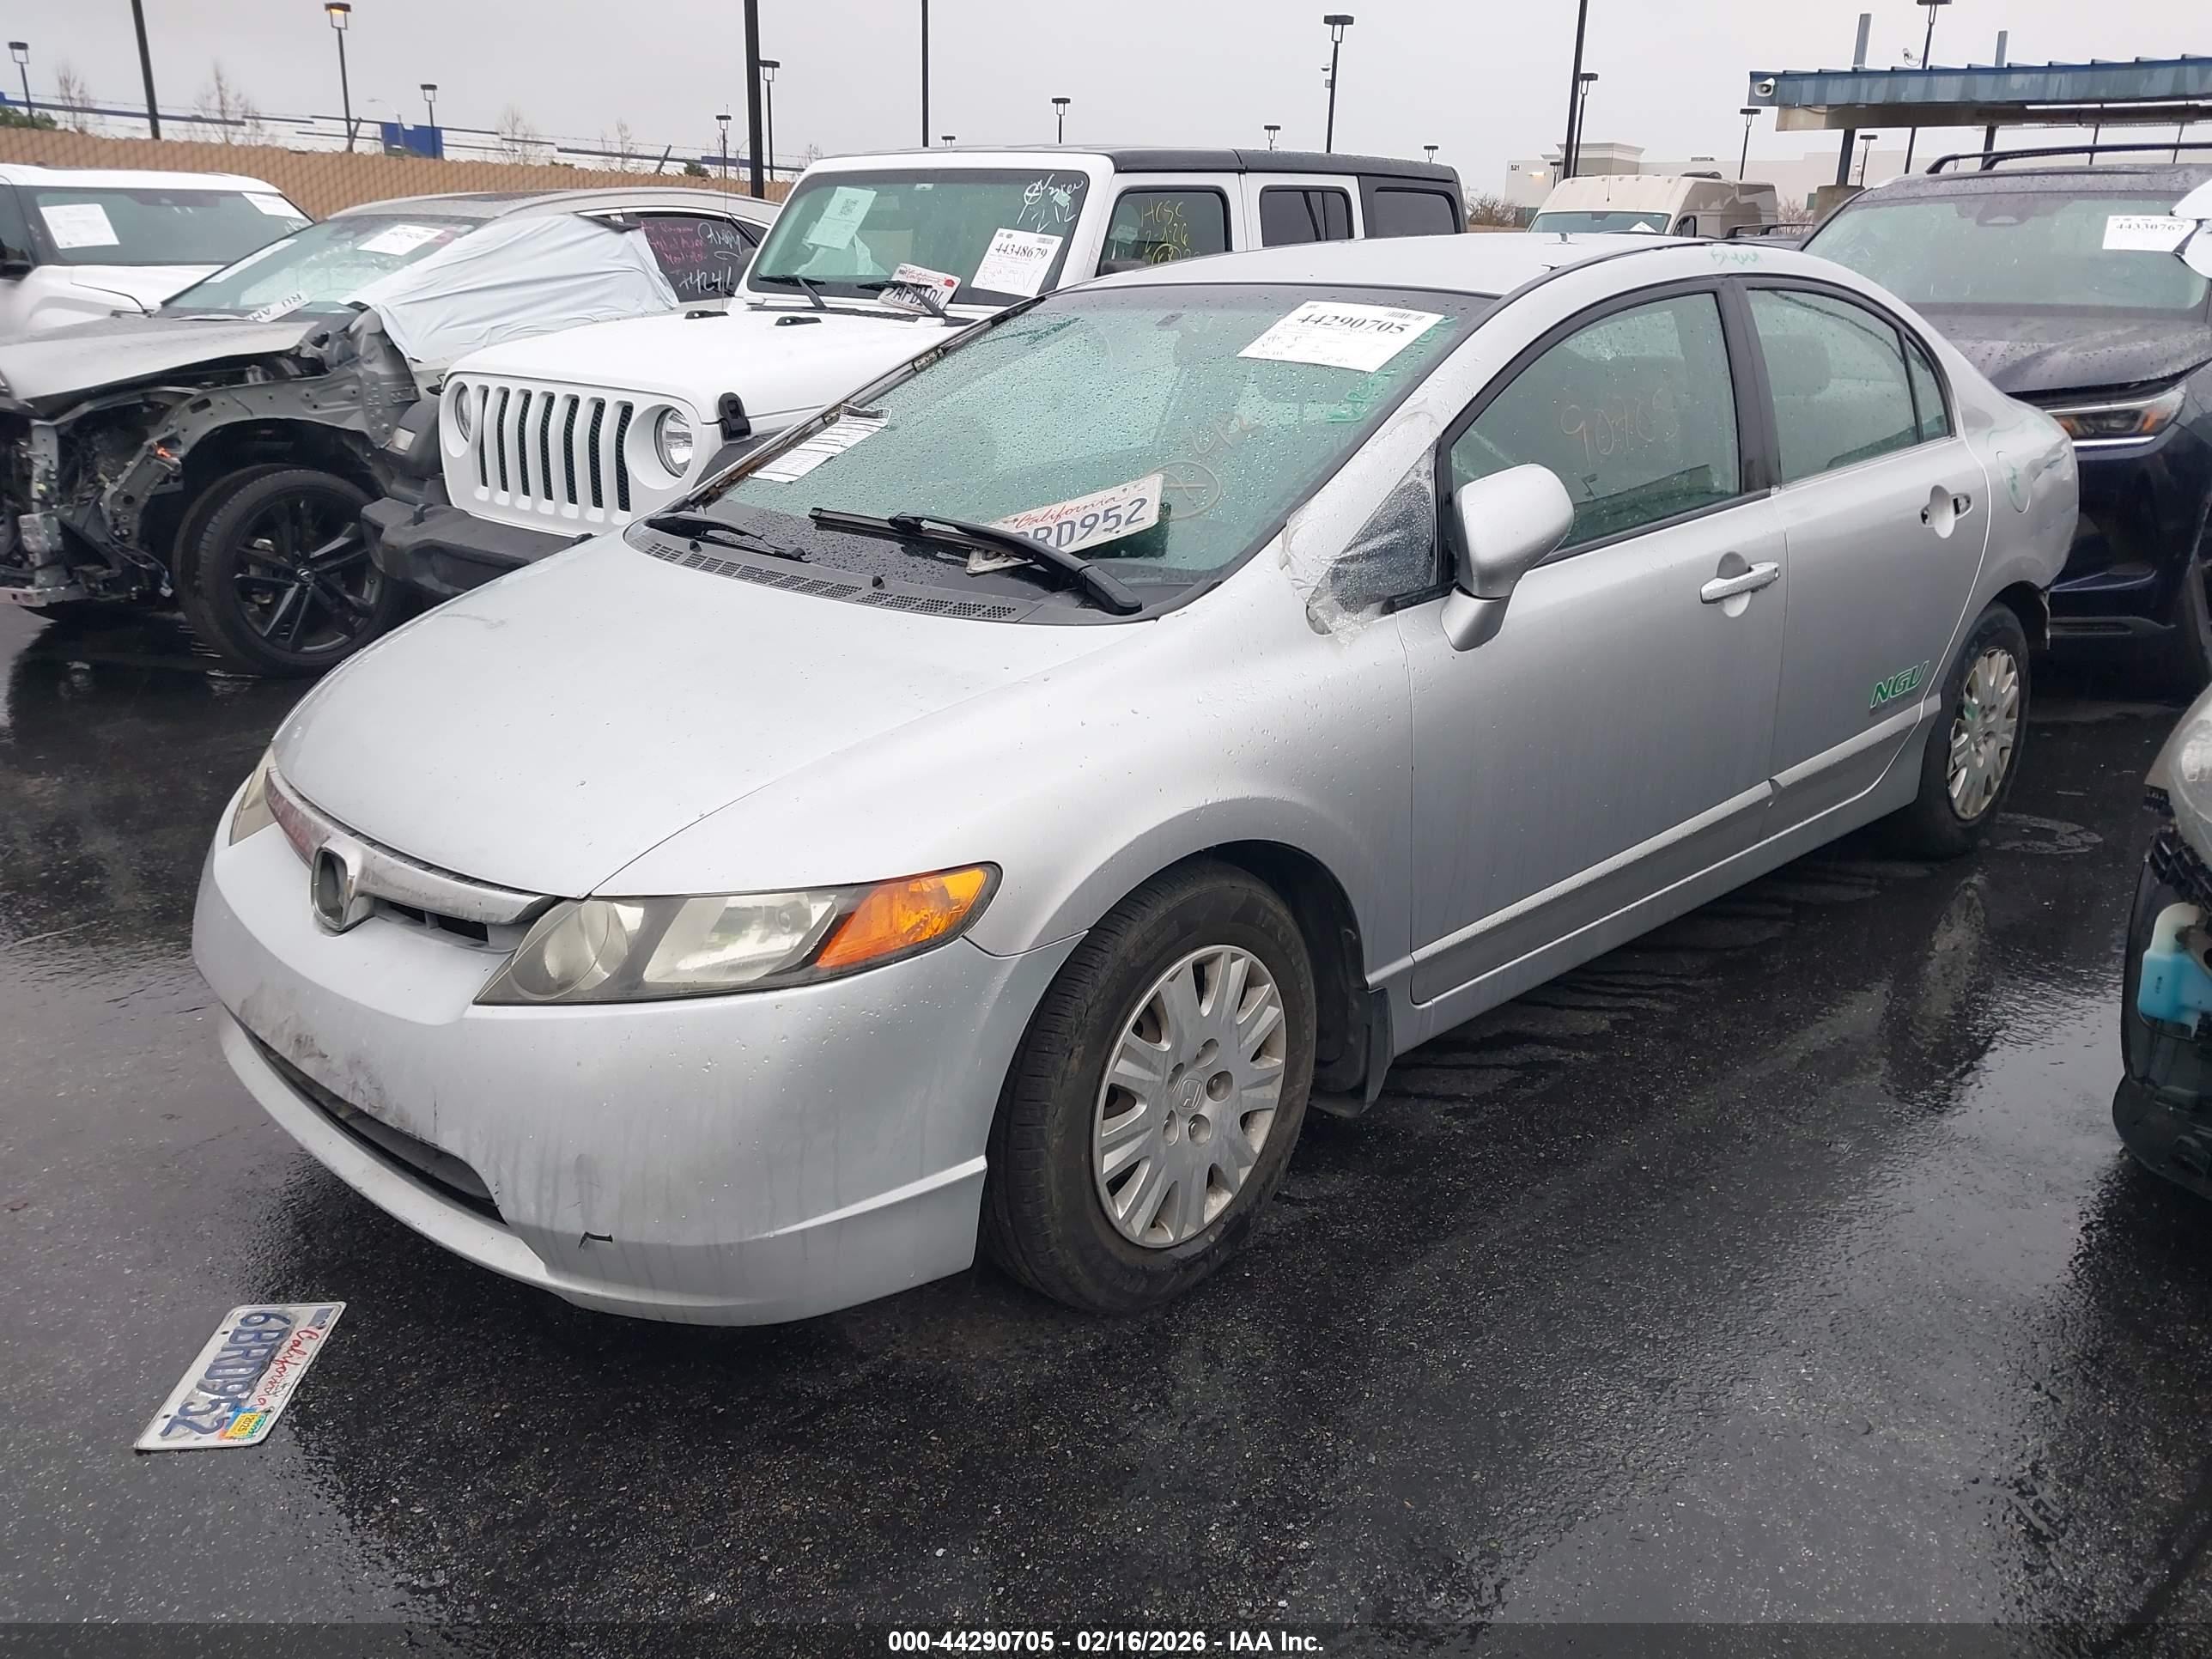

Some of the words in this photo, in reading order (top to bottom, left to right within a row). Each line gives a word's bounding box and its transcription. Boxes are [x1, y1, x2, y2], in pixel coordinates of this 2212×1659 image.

[995, 243, 1048, 260] 44348679
[1297, 313, 1410, 334] 44290705
[1015, 494, 1127, 528] California
[159, 1311, 293, 1437] 6BRD952
